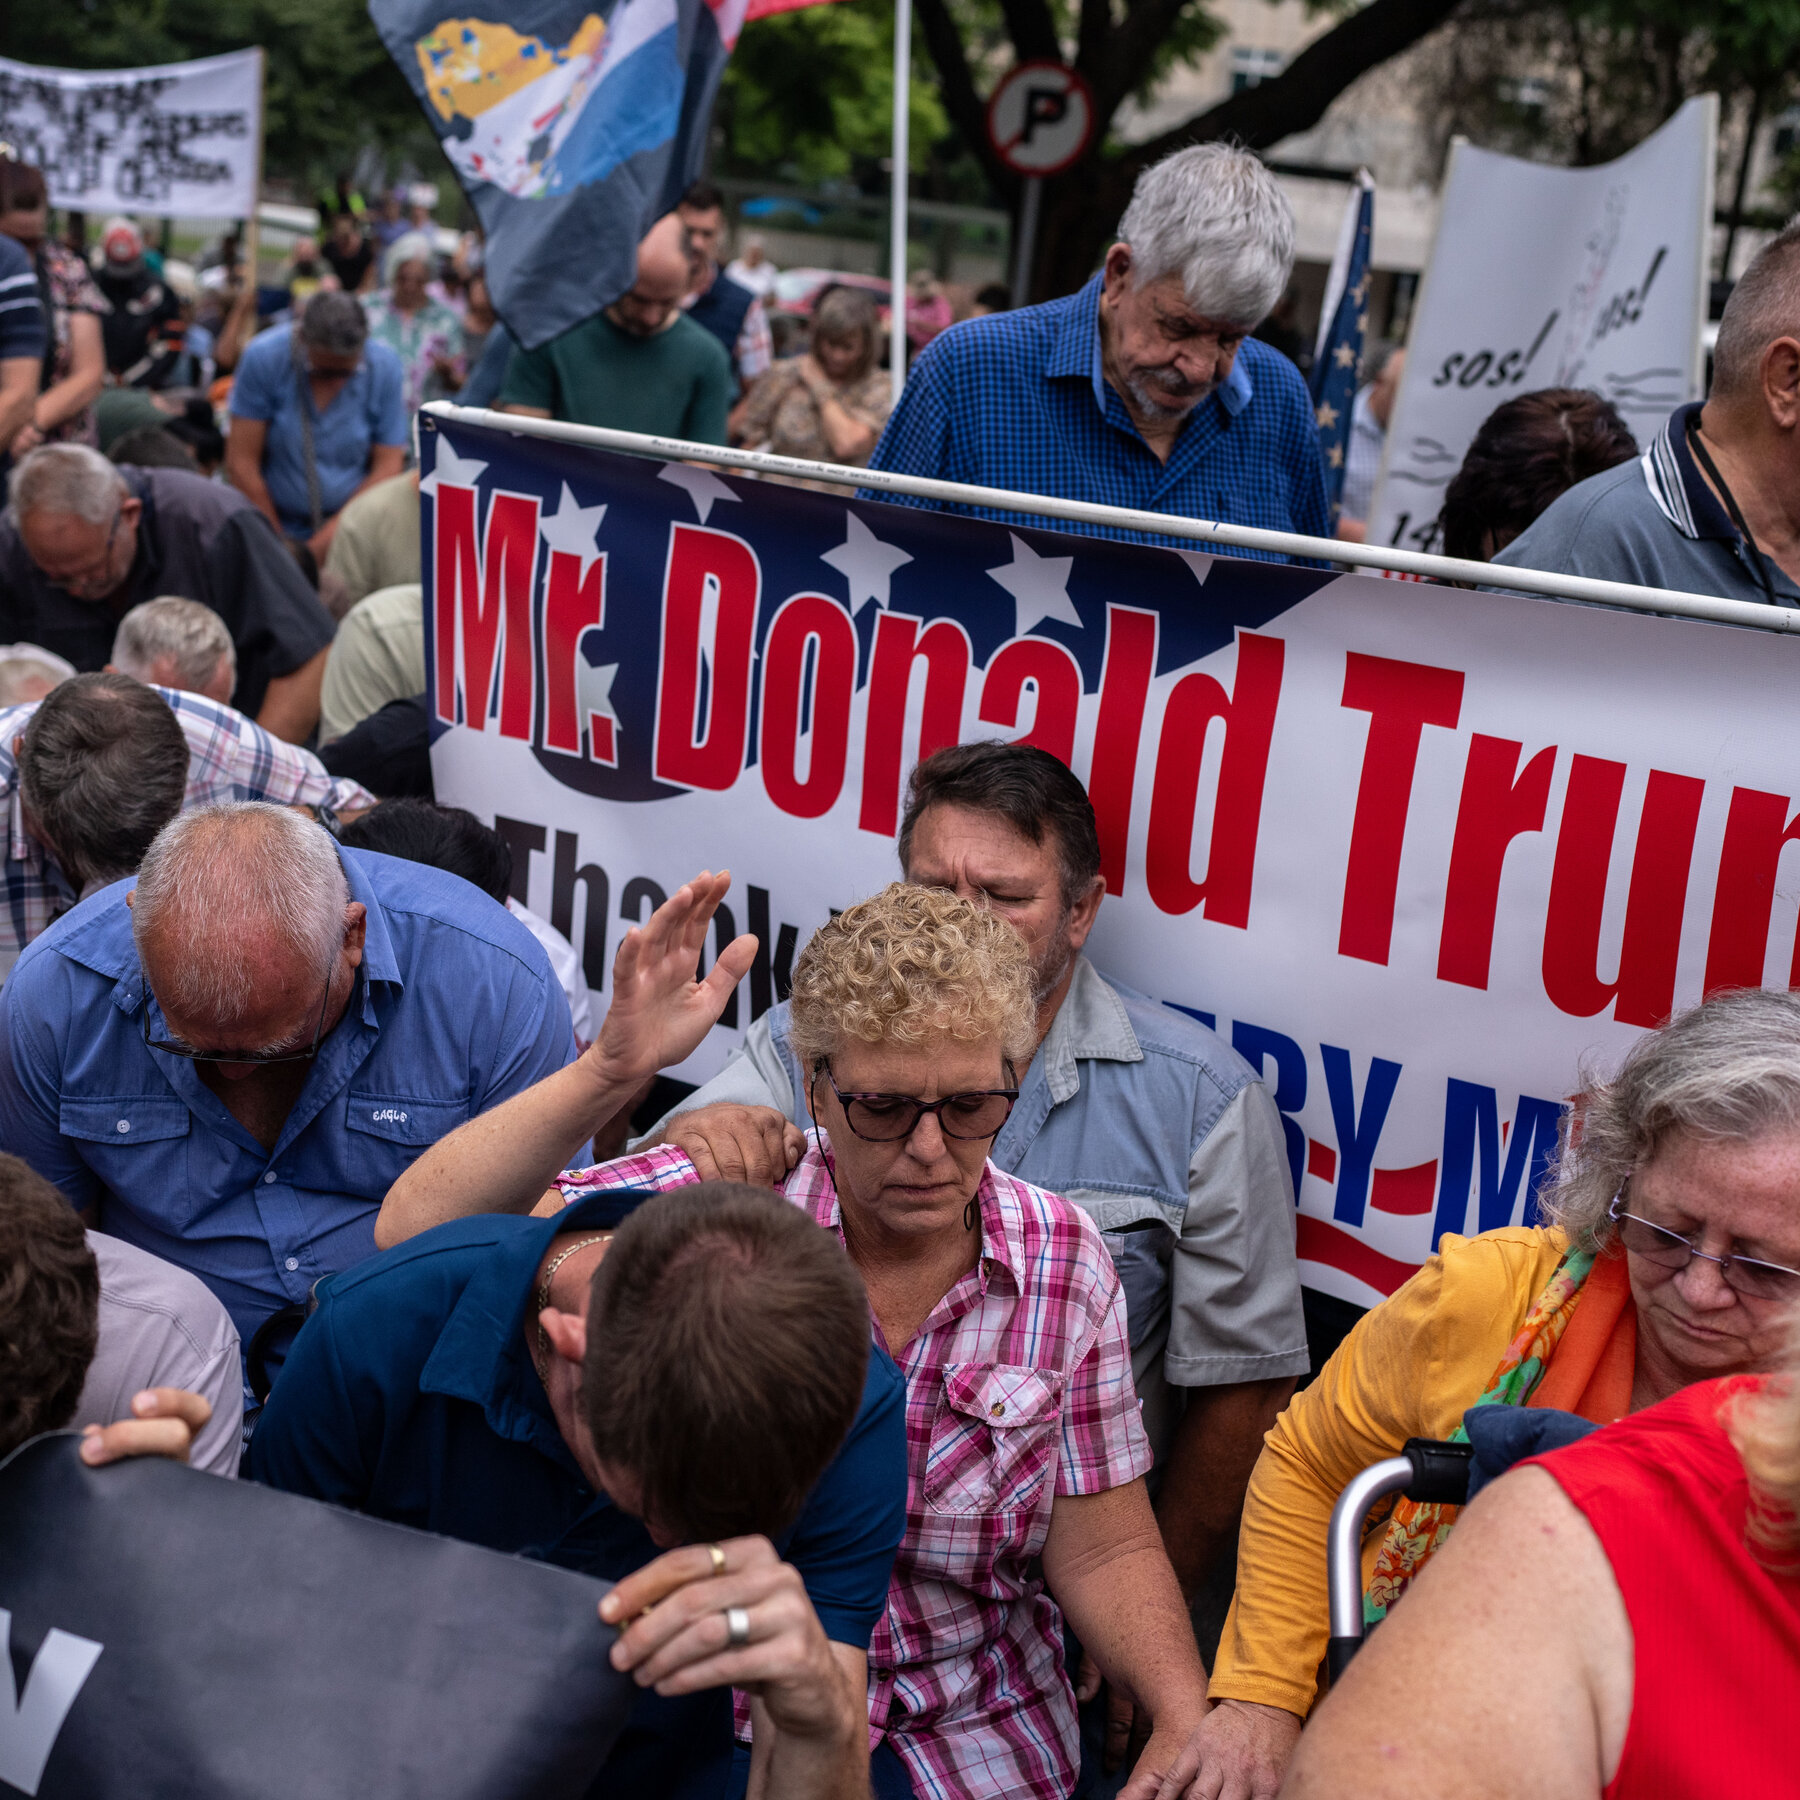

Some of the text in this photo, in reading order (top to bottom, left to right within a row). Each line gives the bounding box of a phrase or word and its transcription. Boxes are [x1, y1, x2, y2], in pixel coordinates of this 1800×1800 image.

[1432, 308, 1560, 388] SOS!
[434, 482, 618, 768] Mr.
[372, 1109, 408, 1123] EAGLE
